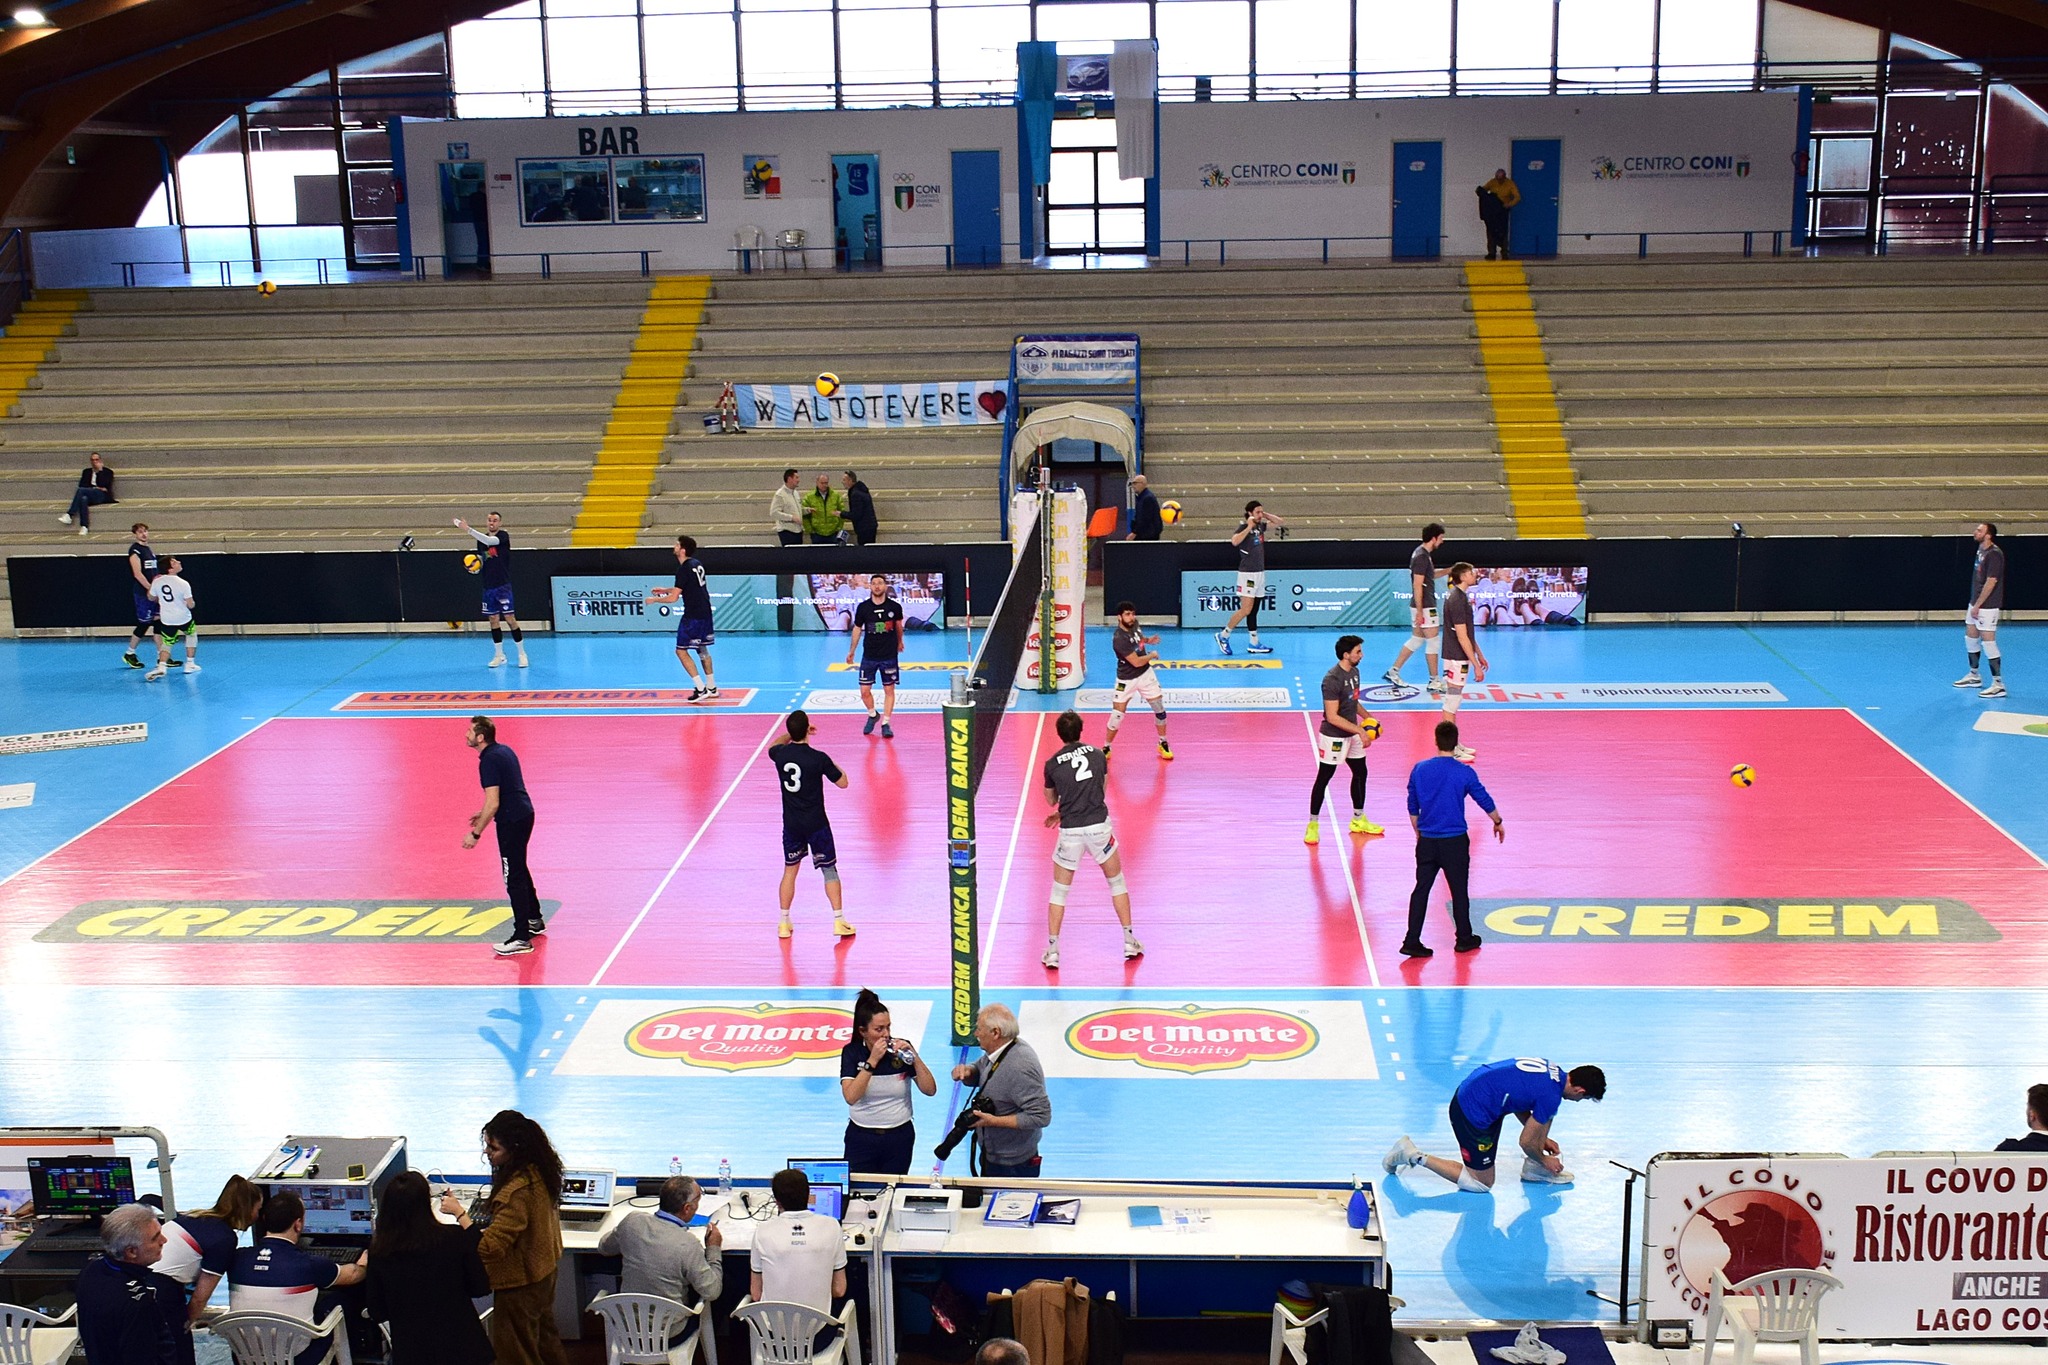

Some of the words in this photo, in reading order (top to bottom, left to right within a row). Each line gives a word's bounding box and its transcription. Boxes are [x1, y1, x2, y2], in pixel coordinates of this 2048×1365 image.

[578, 126, 640, 156] BAR
[1231, 164, 1292, 179] CENTRO
[1296, 163, 1338, 177] CONI
[1624, 156, 1685, 171] CENTRO
[1689, 156, 1733, 170] CONI
[915, 185, 941, 194] CONI
[793, 391, 972, 423] ALTOTEVERE
[692, 565, 706, 587] 12
[161, 584, 174, 602] 9
[568, 590, 643, 598] CAMPING
[1197, 585, 1277, 593] CAMG
[1476, 590, 1497, 599] relax
[1506, 590, 1543, 599] Camping
[1545, 589, 1577, 599] Torrette
[568, 600, 644, 616] TORRETTE
[755, 596, 801, 606] Tranquillità,
[802, 597, 827, 607] riposo
[836, 596, 856, 605] relax
[902, 595, 935, 605] Torrette
[507, 691, 658, 700] PERUGIA
[41, 724, 144, 740] BRUGONI
[951, 718, 969, 790] BANCA
[783, 762, 802, 793] 3
[1071, 755, 1093, 782] 2
[76, 906, 514, 937] CREDEM
[953, 886, 970, 954] BANCA
[1483, 904, 1940, 936] CREDEM
[954, 960, 971, 1037] CREDEM
[649, 1023, 714, 1041] Del
[717, 1022, 851, 1042] Monte
[1089, 1025, 1158, 1043] Del
[1162, 1025, 1299, 1044] Monte
[698, 1042, 788, 1056] Quality
[1147, 1043, 1237, 1057] Quality
[1684, 1184, 1713, 1211] IL
[1728, 1169, 1823, 1211] COVO
[1886, 1168, 1915, 1194] IL
[1925, 1167, 2016, 1194] COVO
[1961, 1276, 2041, 1297] ANCHE
[1916, 1308, 1992, 1332] LAGO
